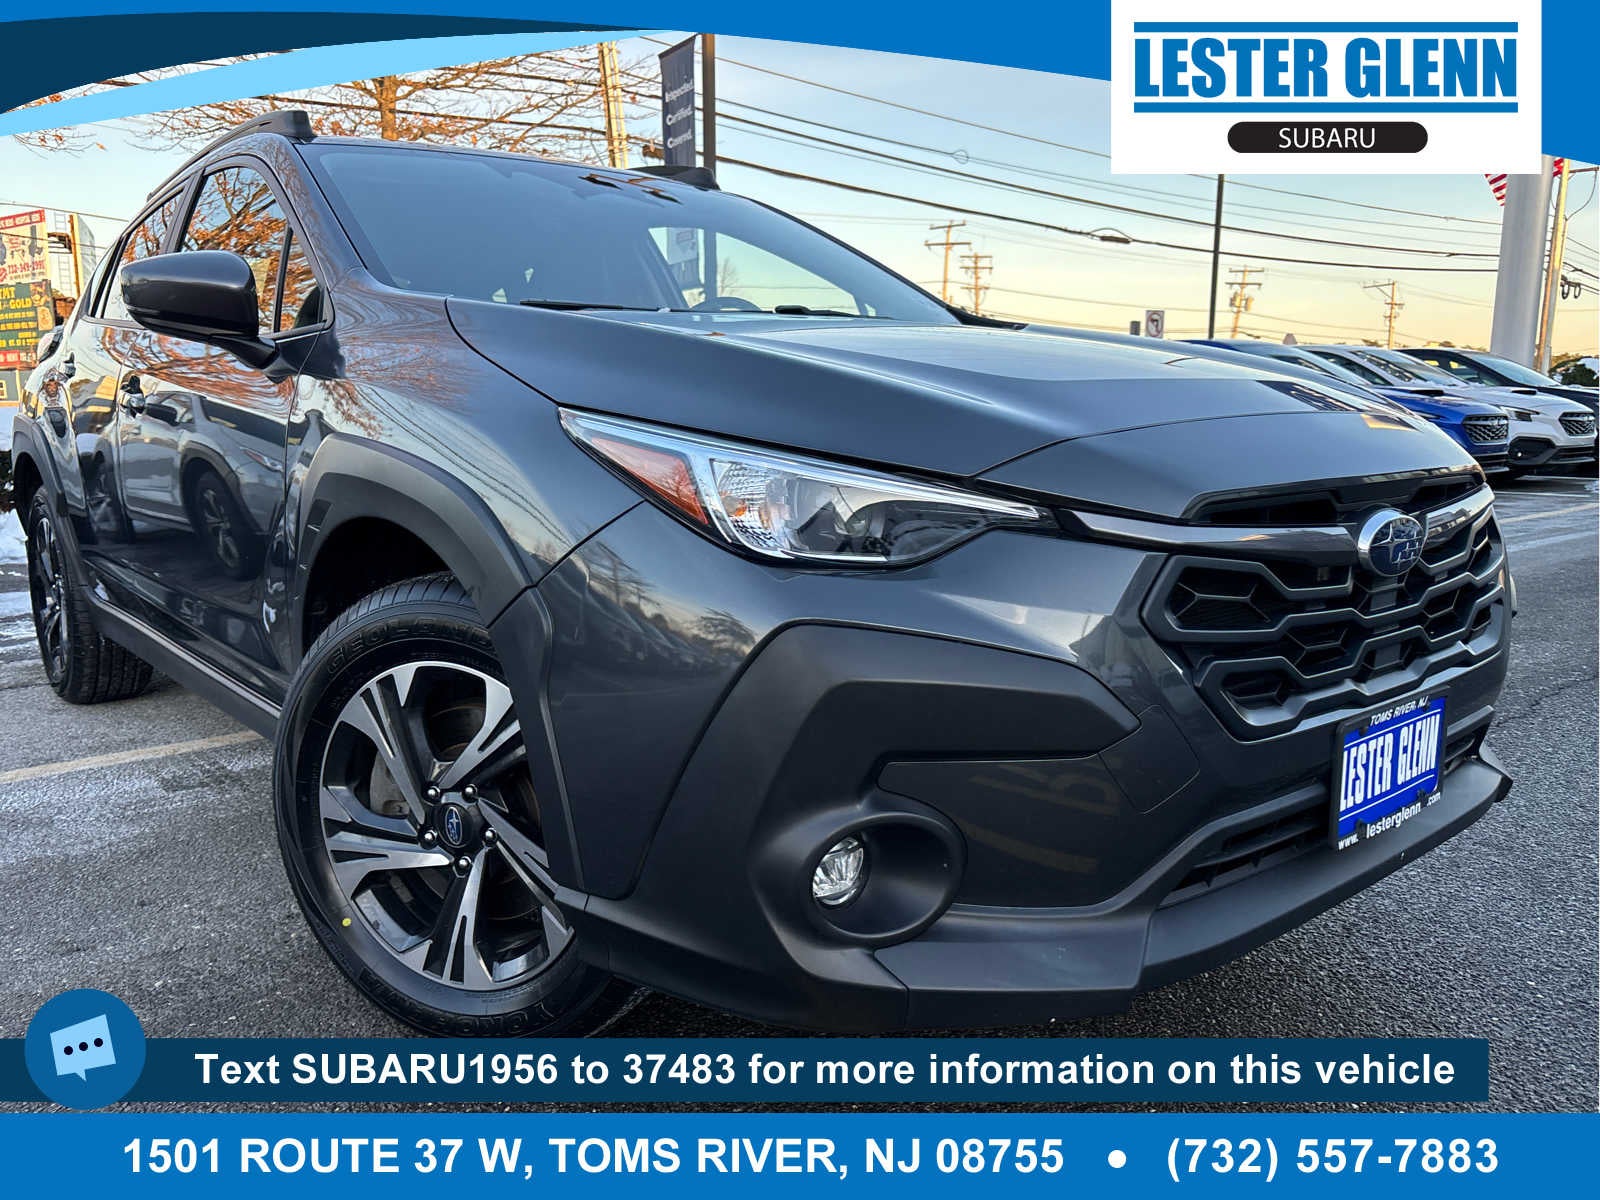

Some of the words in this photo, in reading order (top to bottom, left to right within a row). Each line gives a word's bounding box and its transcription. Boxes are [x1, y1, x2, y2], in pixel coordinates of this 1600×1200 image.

[9, 297, 32, 310] GOLD
[1370, 709, 1393, 726] TOMS
[1417, 695, 1429, 709] NJ
[1340, 733, 1394, 812] LESTER
[1397, 714, 1440, 786] GLENN
[1338, 832, 1359, 851] www.
[1366, 801, 1421, 839] lesterglenn
[1426, 791, 1441, 807] .com
